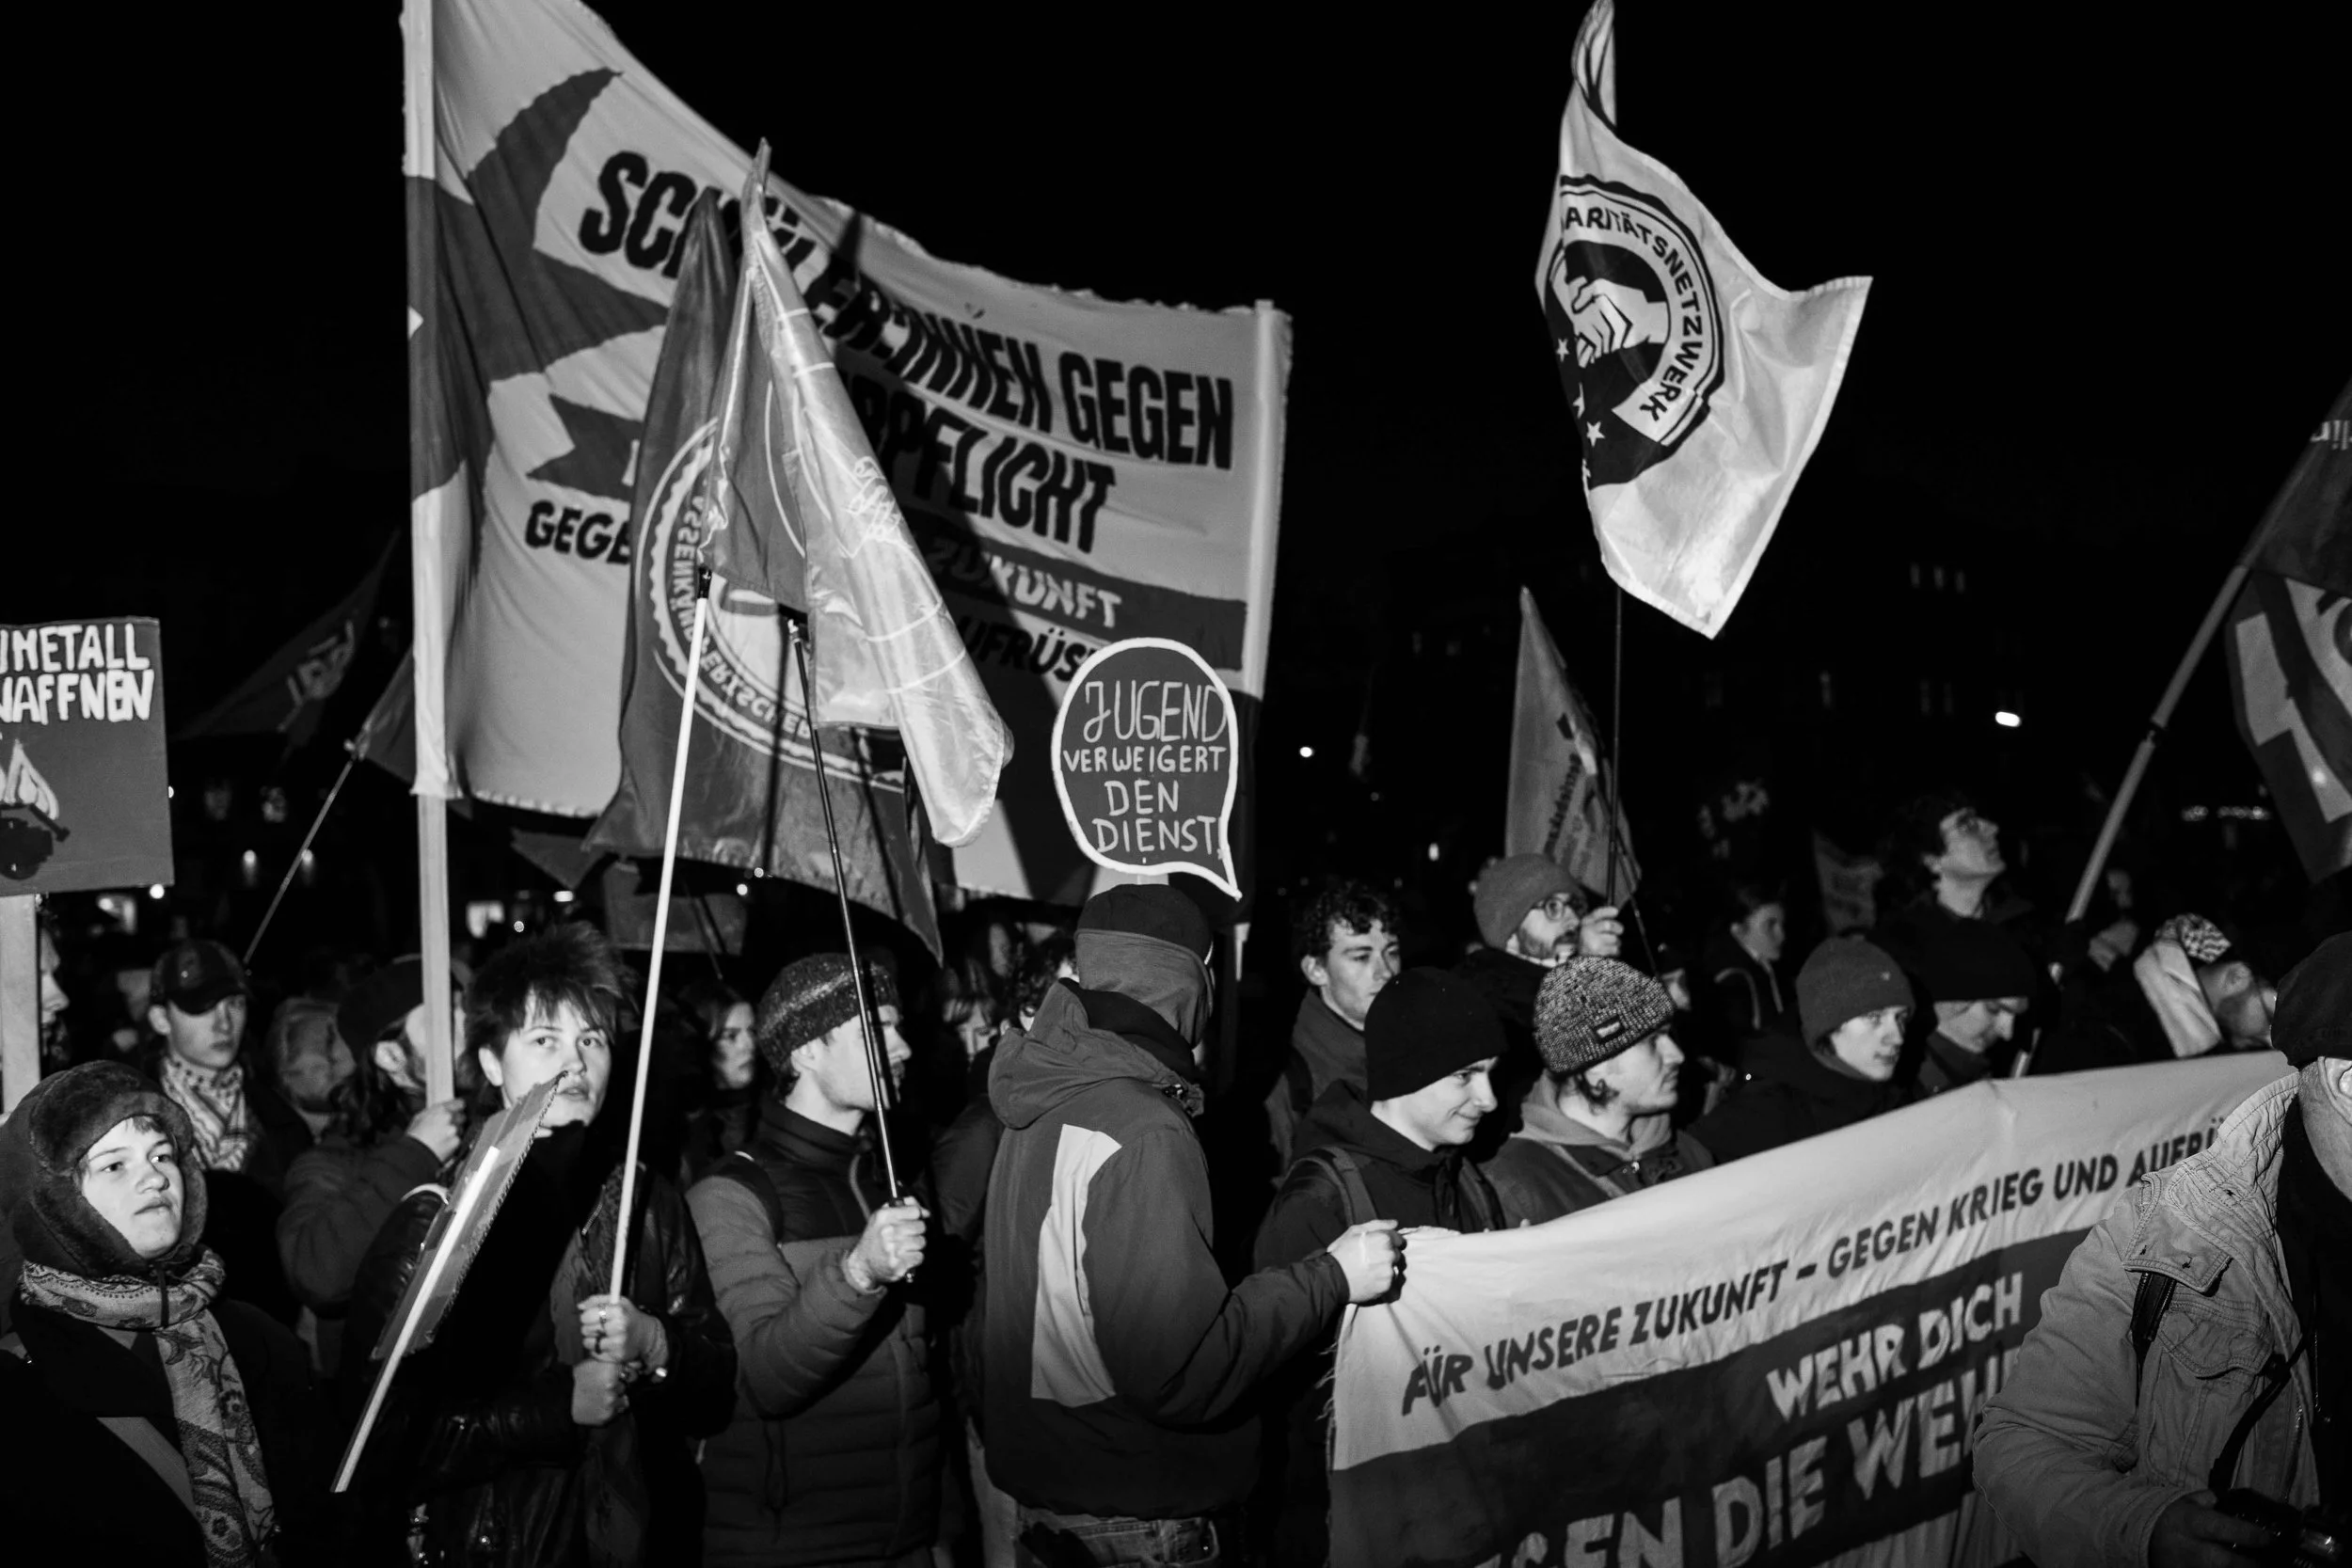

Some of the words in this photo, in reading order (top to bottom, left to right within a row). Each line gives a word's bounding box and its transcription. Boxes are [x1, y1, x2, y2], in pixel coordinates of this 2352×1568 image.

[1565, 206, 1704, 421] ARITÄTSNETZWERK
[1058, 351, 1232, 469] GEGEN
[525, 500, 630, 564] GEGE
[926, 535, 1122, 629] ZUKUNFT
[1062, 744, 1228, 773] VERWEIGERT
[1083, 679, 1228, 743] JUGEND
[1104, 779, 1180, 816] DEN
[1484, 1307, 1622, 1390] UNSERE
[1629, 1259, 1788, 1346] ZUKUNFT
[1827, 1206, 1940, 1278] GEGEN
[1947, 1168, 2044, 1238] KRIEG
[2054, 1153, 2119, 1200] UND
[1766, 1323, 1908, 1422] WEHR
[1917, 1271, 2024, 1370] DICH
[1712, 1434, 1829, 1568] DIE
